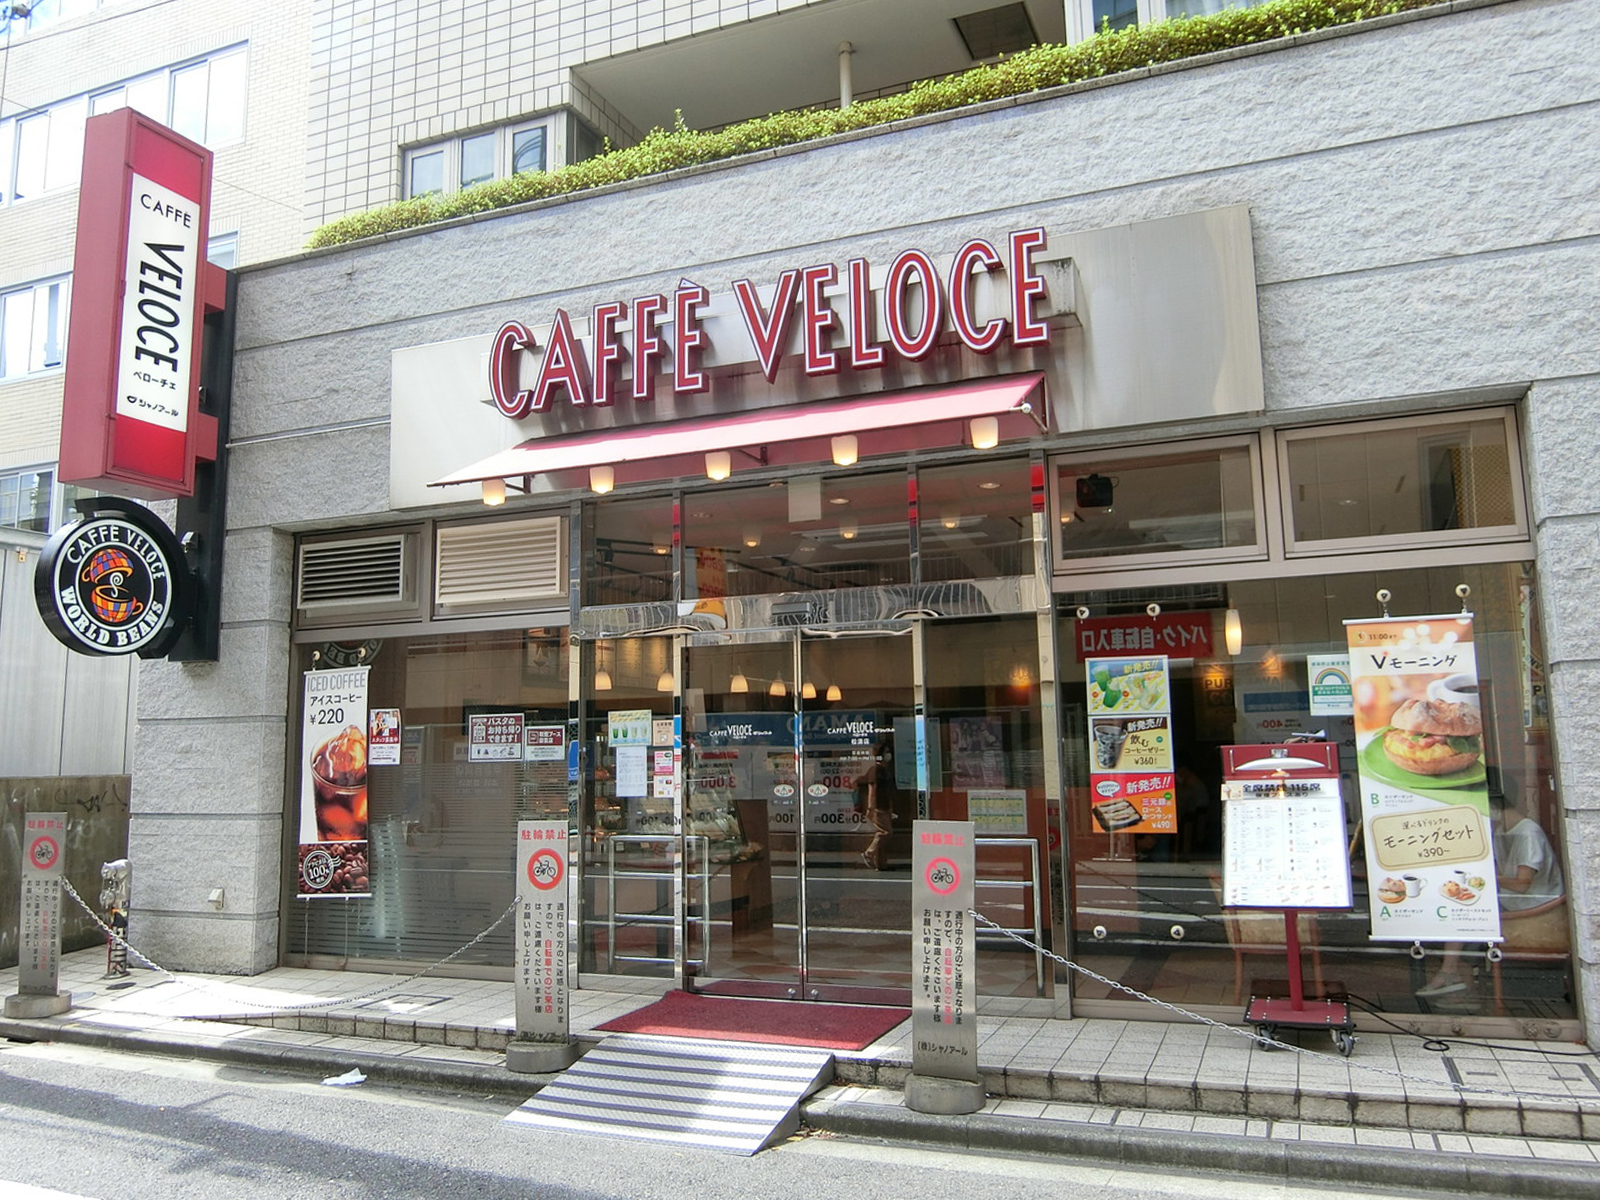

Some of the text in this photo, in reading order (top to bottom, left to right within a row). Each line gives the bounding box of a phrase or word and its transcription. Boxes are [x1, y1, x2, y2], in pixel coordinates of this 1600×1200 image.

[135, 242, 185, 373] VELOCE
[488, 226, 1051, 420] CAFFÈ VELOCE
[133, 370, 176, 391] ベローチェ
[138, 398, 179, 417] シャノアール
[127, 529, 166, 580] VELOCE
[61, 585, 163, 646] WORLD BEANS
[307, 672, 366, 692] ICED COFFEE
[310, 694, 362, 706] アイスコーヒー
[310, 708, 344, 725] ¥220
[488, 717, 515, 725] パスタの
[488, 725, 521, 735] お持ち帰り
[727, 725, 752, 736] VELOCE
[846, 722, 873, 733] VELOCE
[1130, 735, 1149, 747] 飲む
[1371, 793, 1379, 804] B
[1402, 818, 1450, 830] 選べるドリンクの
[521, 829, 566, 840] 駐輪禁止
[1384, 825, 1474, 848] モーニングセット
[1380, 901, 1391, 917] A
[1437, 901, 1448, 918] C
